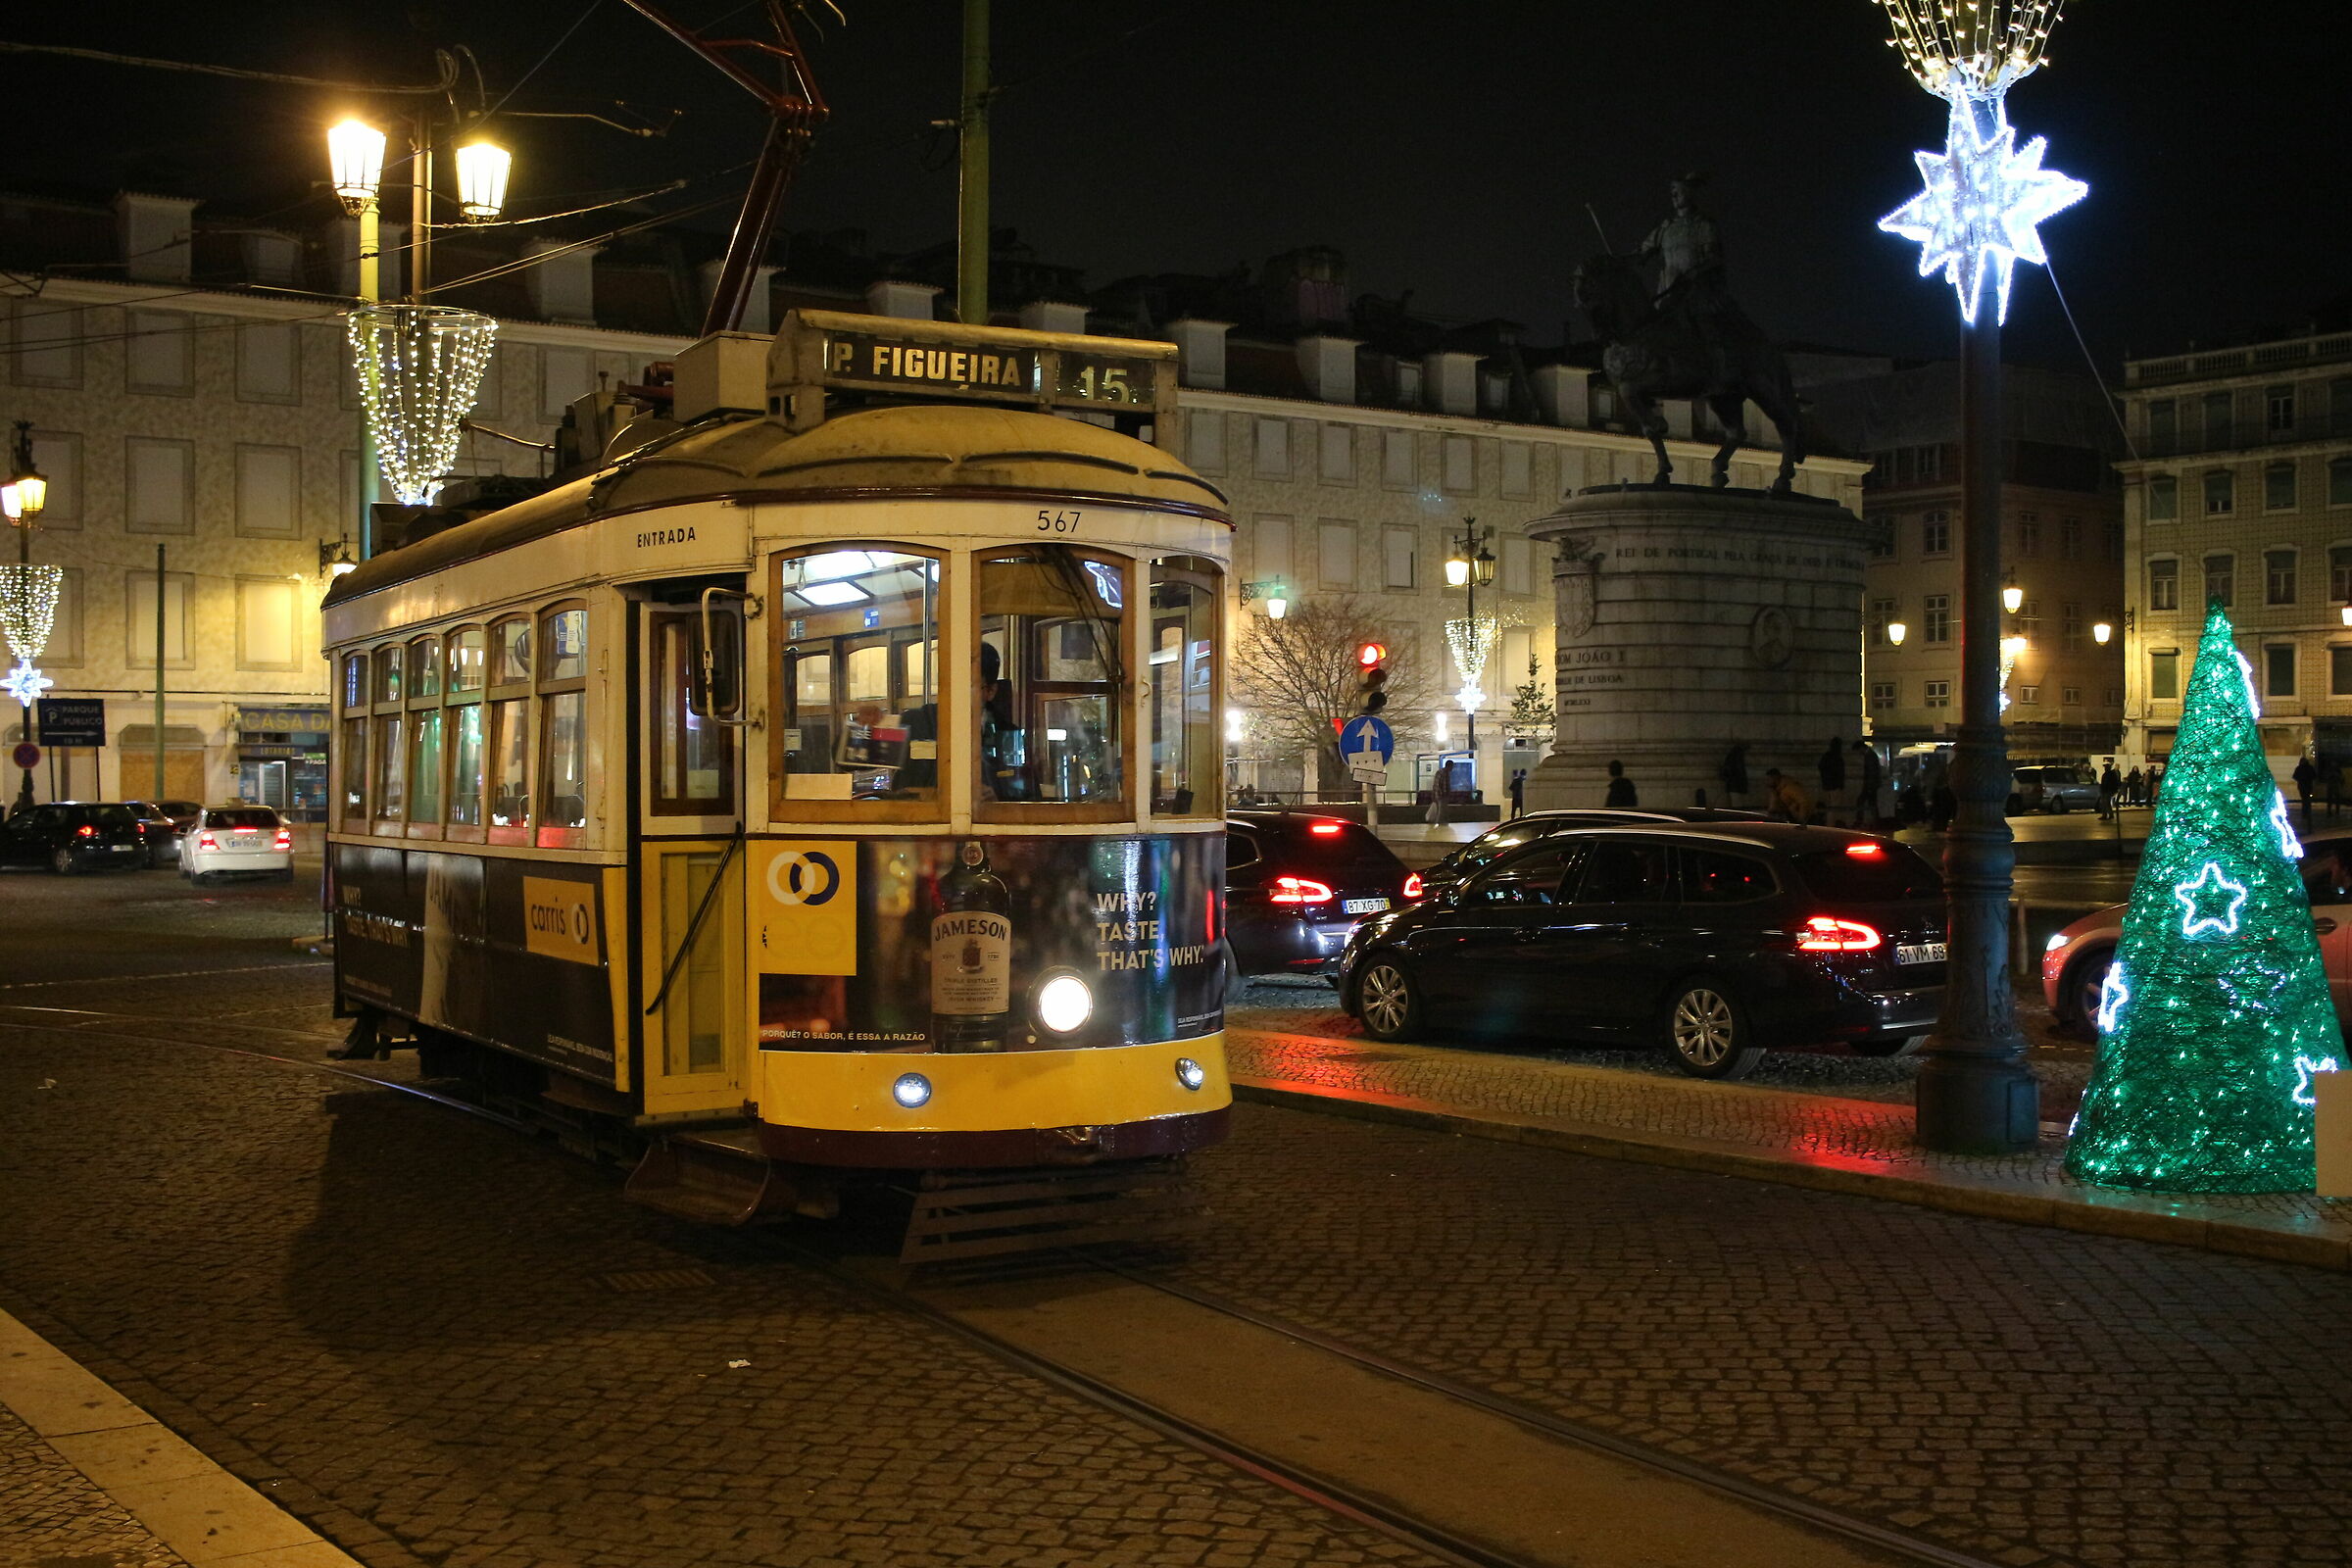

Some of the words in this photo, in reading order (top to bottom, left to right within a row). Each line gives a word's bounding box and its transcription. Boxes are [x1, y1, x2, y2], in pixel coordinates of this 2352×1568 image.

[833, 342, 853, 372] P.
[872, 346, 1022, 387] FIGUEIRA
[1079, 366, 1130, 403] 15
[1037, 510, 1082, 533] 567
[637, 526, 696, 548] ENTRADA
[1643, 547, 1659, 558] DE
[1575, 649, 1612, 664] JOÃO
[62, 706, 100, 714] PARQUE
[244, 711, 305, 730] CASA
[1097, 891, 1157, 912] WHY?
[530, 896, 566, 935] carris
[934, 919, 1007, 942] JAMESON
[1097, 948, 1164, 971] THAT'S
[812, 1032, 846, 1041] SABOR,
[893, 1031, 926, 1041] RAZÃO
